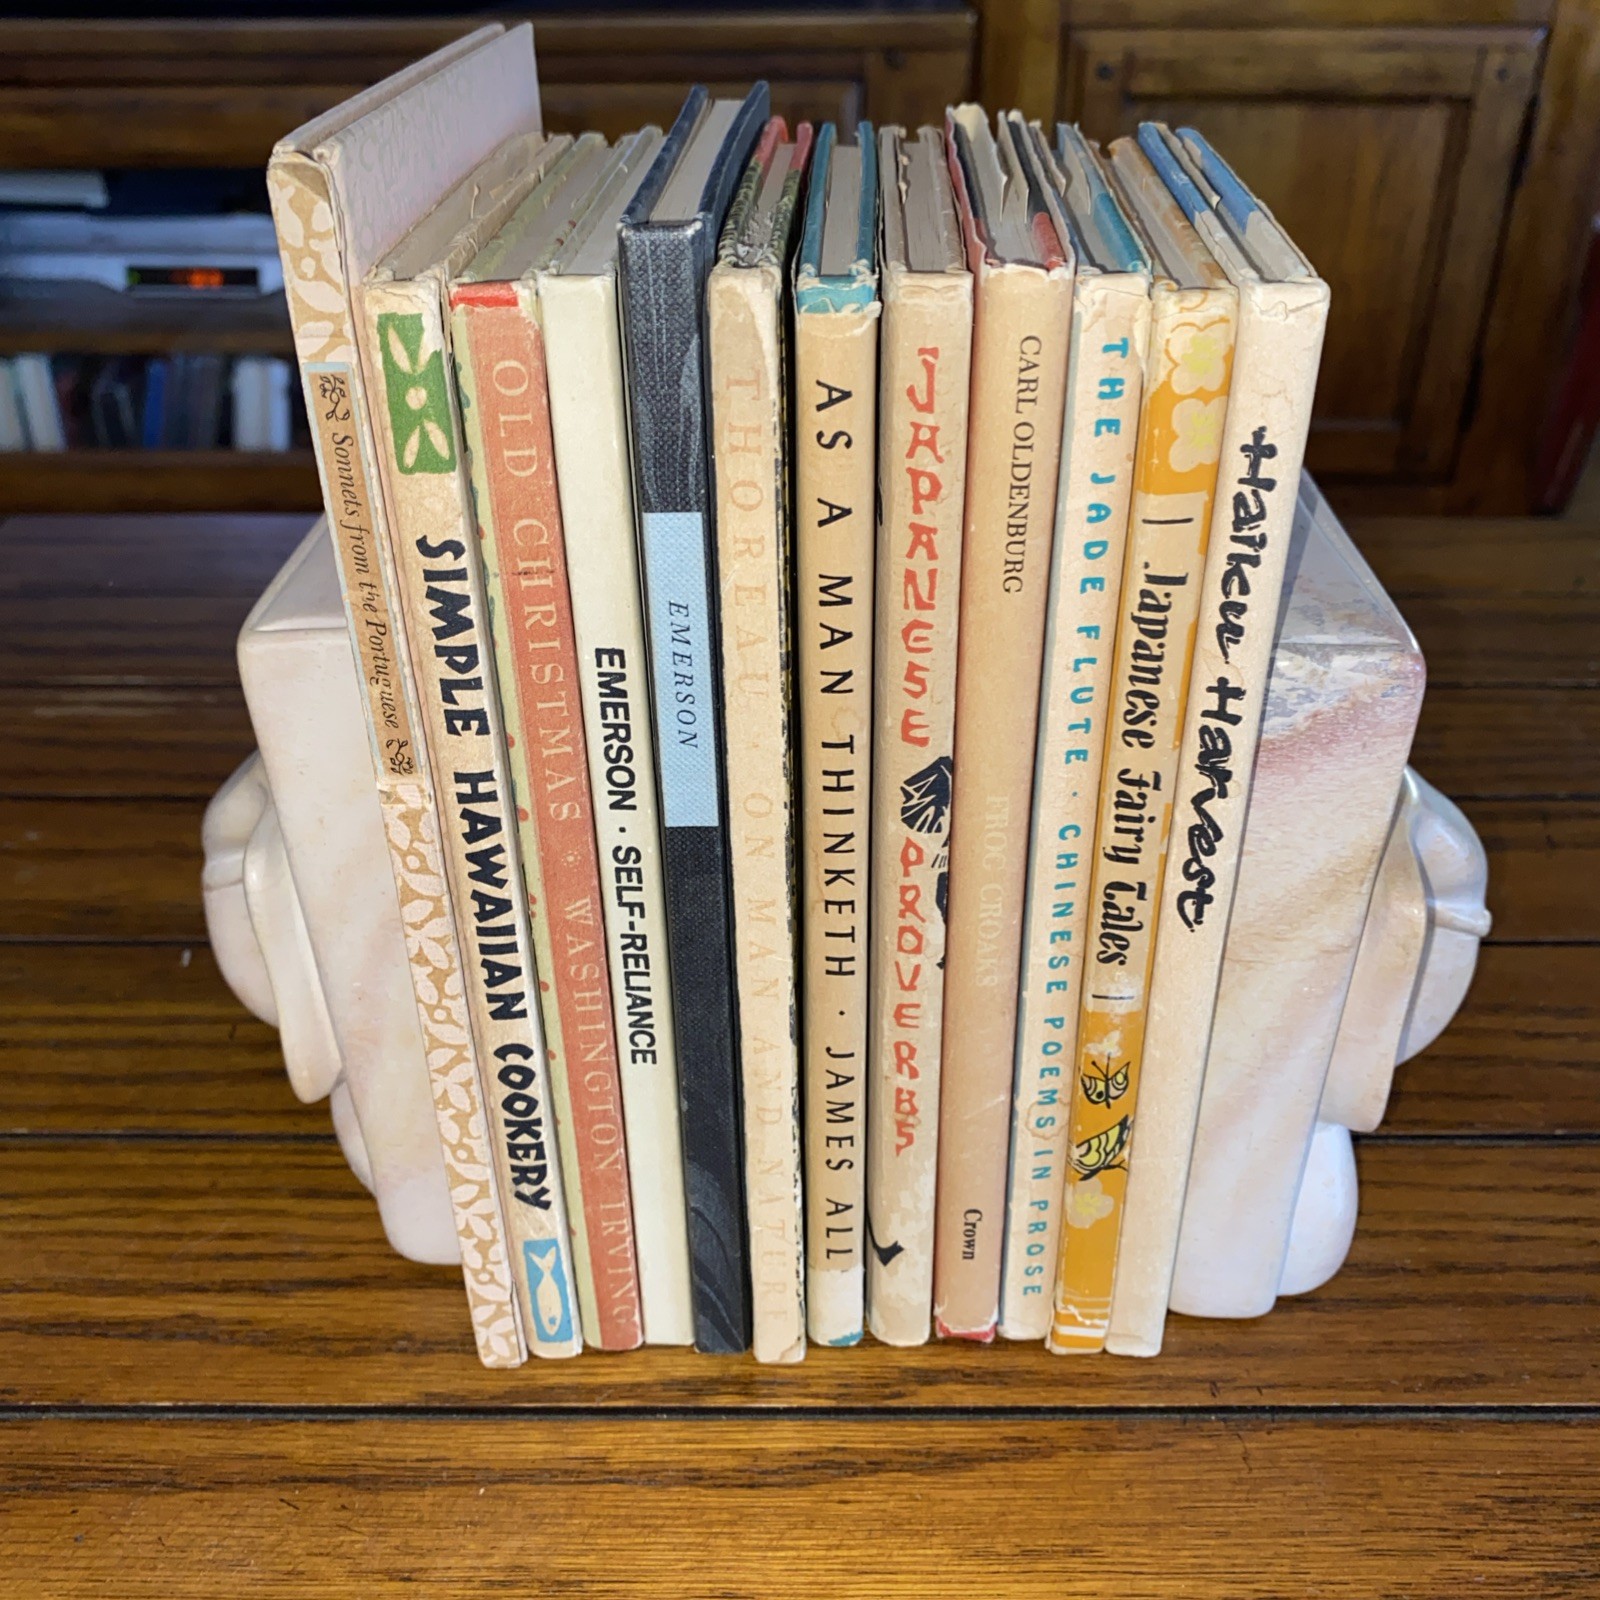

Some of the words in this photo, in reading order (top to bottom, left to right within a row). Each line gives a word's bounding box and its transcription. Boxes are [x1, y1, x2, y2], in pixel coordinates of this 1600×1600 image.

[493, 360, 538, 479] OLD
[814, 379, 855, 452] AS
[1010, 333, 1042, 415] CARL
[1093, 336, 1130, 438] THE
[331, 430, 362, 521] Sonnets
[725, 368, 769, 699] THOREAU
[816, 497, 854, 530] A
[1002, 420, 1036, 596] OLDENBURG
[1079, 471, 1117, 596] JADE
[340, 519, 371, 576] from
[353, 579, 379, 614] the
[901, 346, 943, 748] JAPANESE
[1216, 425, 1278, 665] Haiku
[364, 618, 401, 730] Portuguese
[512, 517, 581, 825] CHRISTMAS
[668, 600, 699, 749] EMERSON
[818, 572, 855, 696] MAN
[1120, 561, 1190, 750] Japanese
[594, 647, 638, 812] EMERSON
[1064, 624, 1101, 767] FLUTE
[742, 792, 775, 860] ON
[821, 733, 857, 977] THINKETH
[982, 795, 1009, 870] FROG
[1103, 767, 1163, 865] Fairy
[1176, 675, 1248, 934] Harvest
[415, 535, 491, 738] SIMPLE
[453, 770, 528, 1021] HAWAIIAN
[493, 1042, 553, 1212] COOKERY
[1046, 824, 1081, 994] CHINESE
[1096, 879, 1147, 967] Tales
[612, 845, 658, 1066] SELF-RELIANCE
[748, 896, 780, 1003] MAN
[974, 882, 1004, 988] CROAKS
[564, 898, 621, 1172] WASHINGTON
[893, 836, 927, 1158] PROVERBS
[754, 1034, 785, 1127] AND
[825, 1045, 855, 1172] JAMES
[1035, 1016, 1065, 1130] POEMS
[1031, 1147, 1057, 1181] IN
[599, 1199, 640, 1326] IRVING
[825, 1198, 854, 1268] ALL
[961, 1206, 984, 1262] Crown
[1021, 1199, 1049, 1298] PROSE
